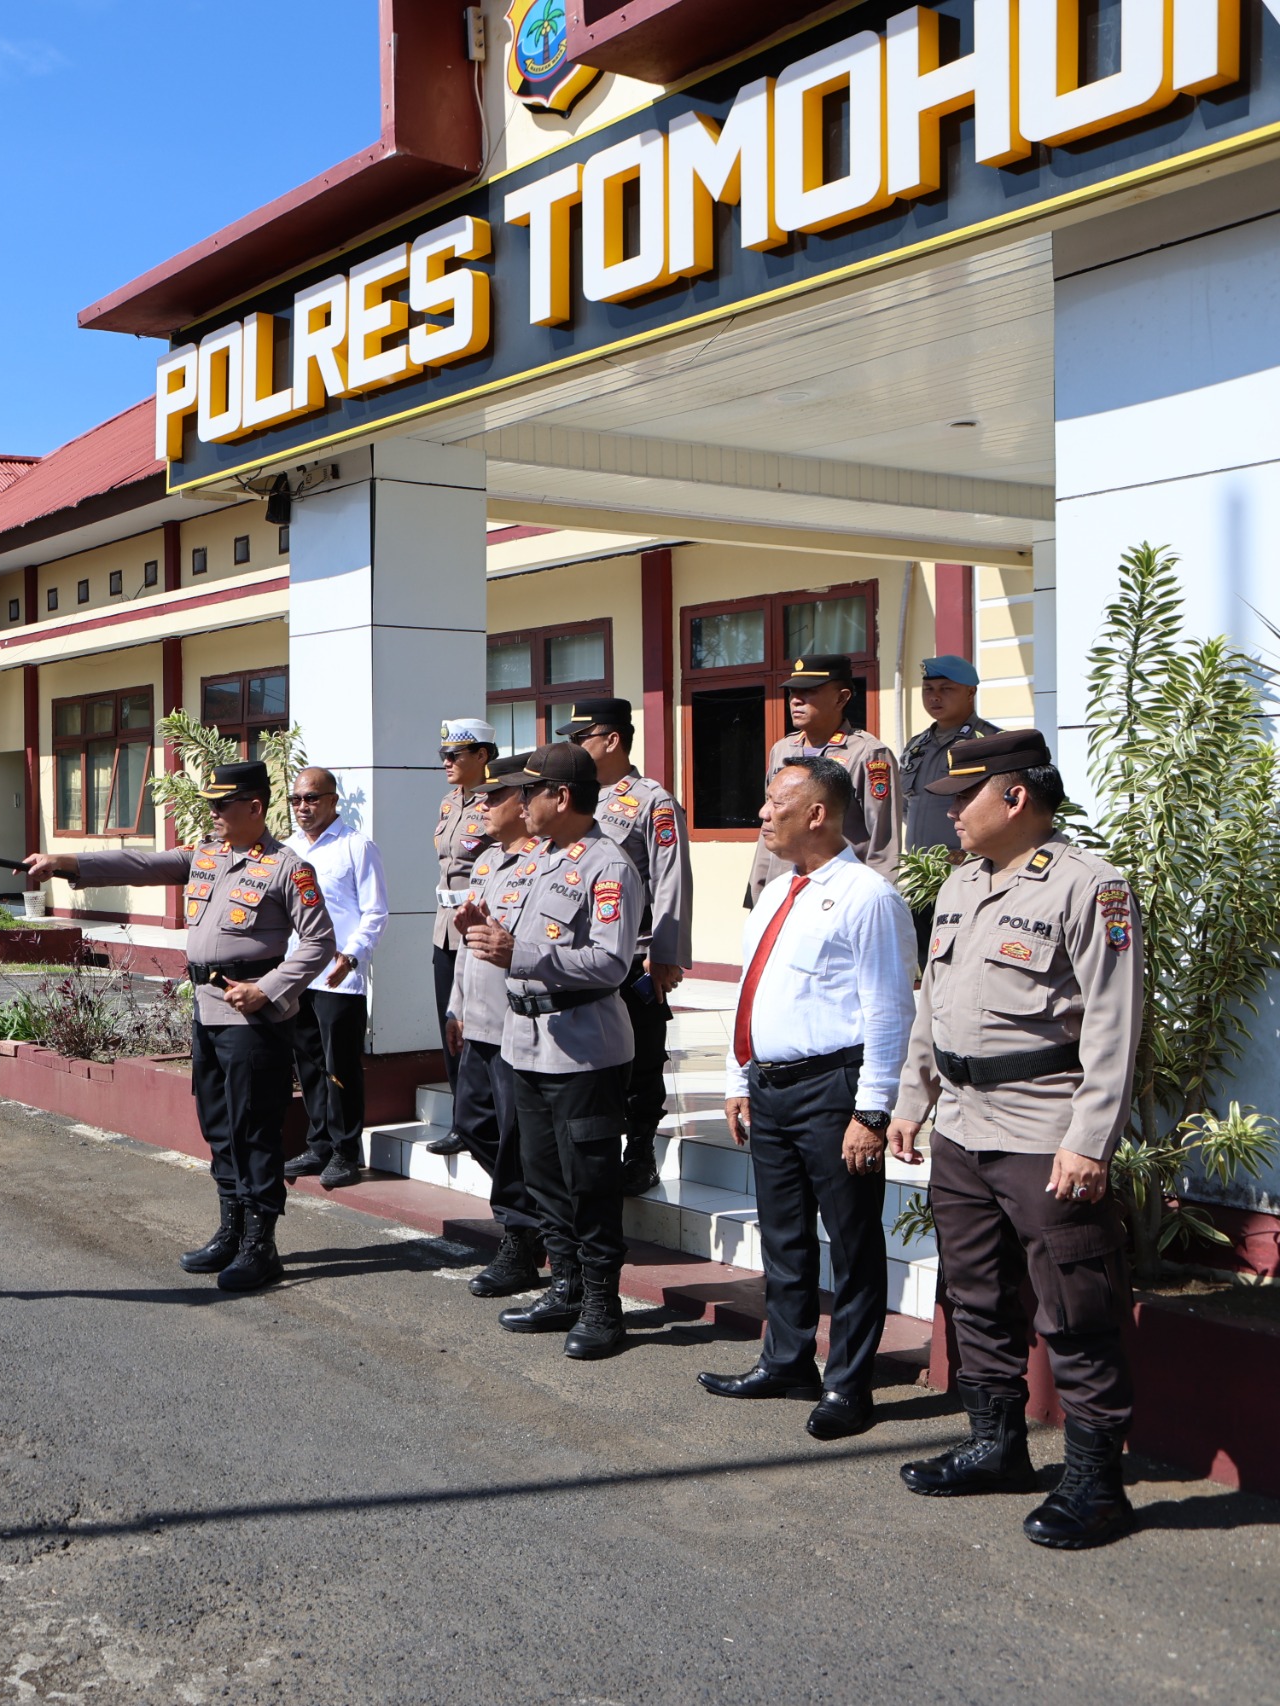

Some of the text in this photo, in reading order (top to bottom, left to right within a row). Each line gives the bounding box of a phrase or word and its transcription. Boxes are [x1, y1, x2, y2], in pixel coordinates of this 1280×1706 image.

[155, 0, 1280, 462] POLRES TOMOHO
[601, 813, 632, 830] POLRI
[190, 870, 216, 882] KHOLIS
[239, 876, 268, 891] POLRI
[549, 882, 583, 903] POLRI
[998, 914, 1054, 937] POLRI
